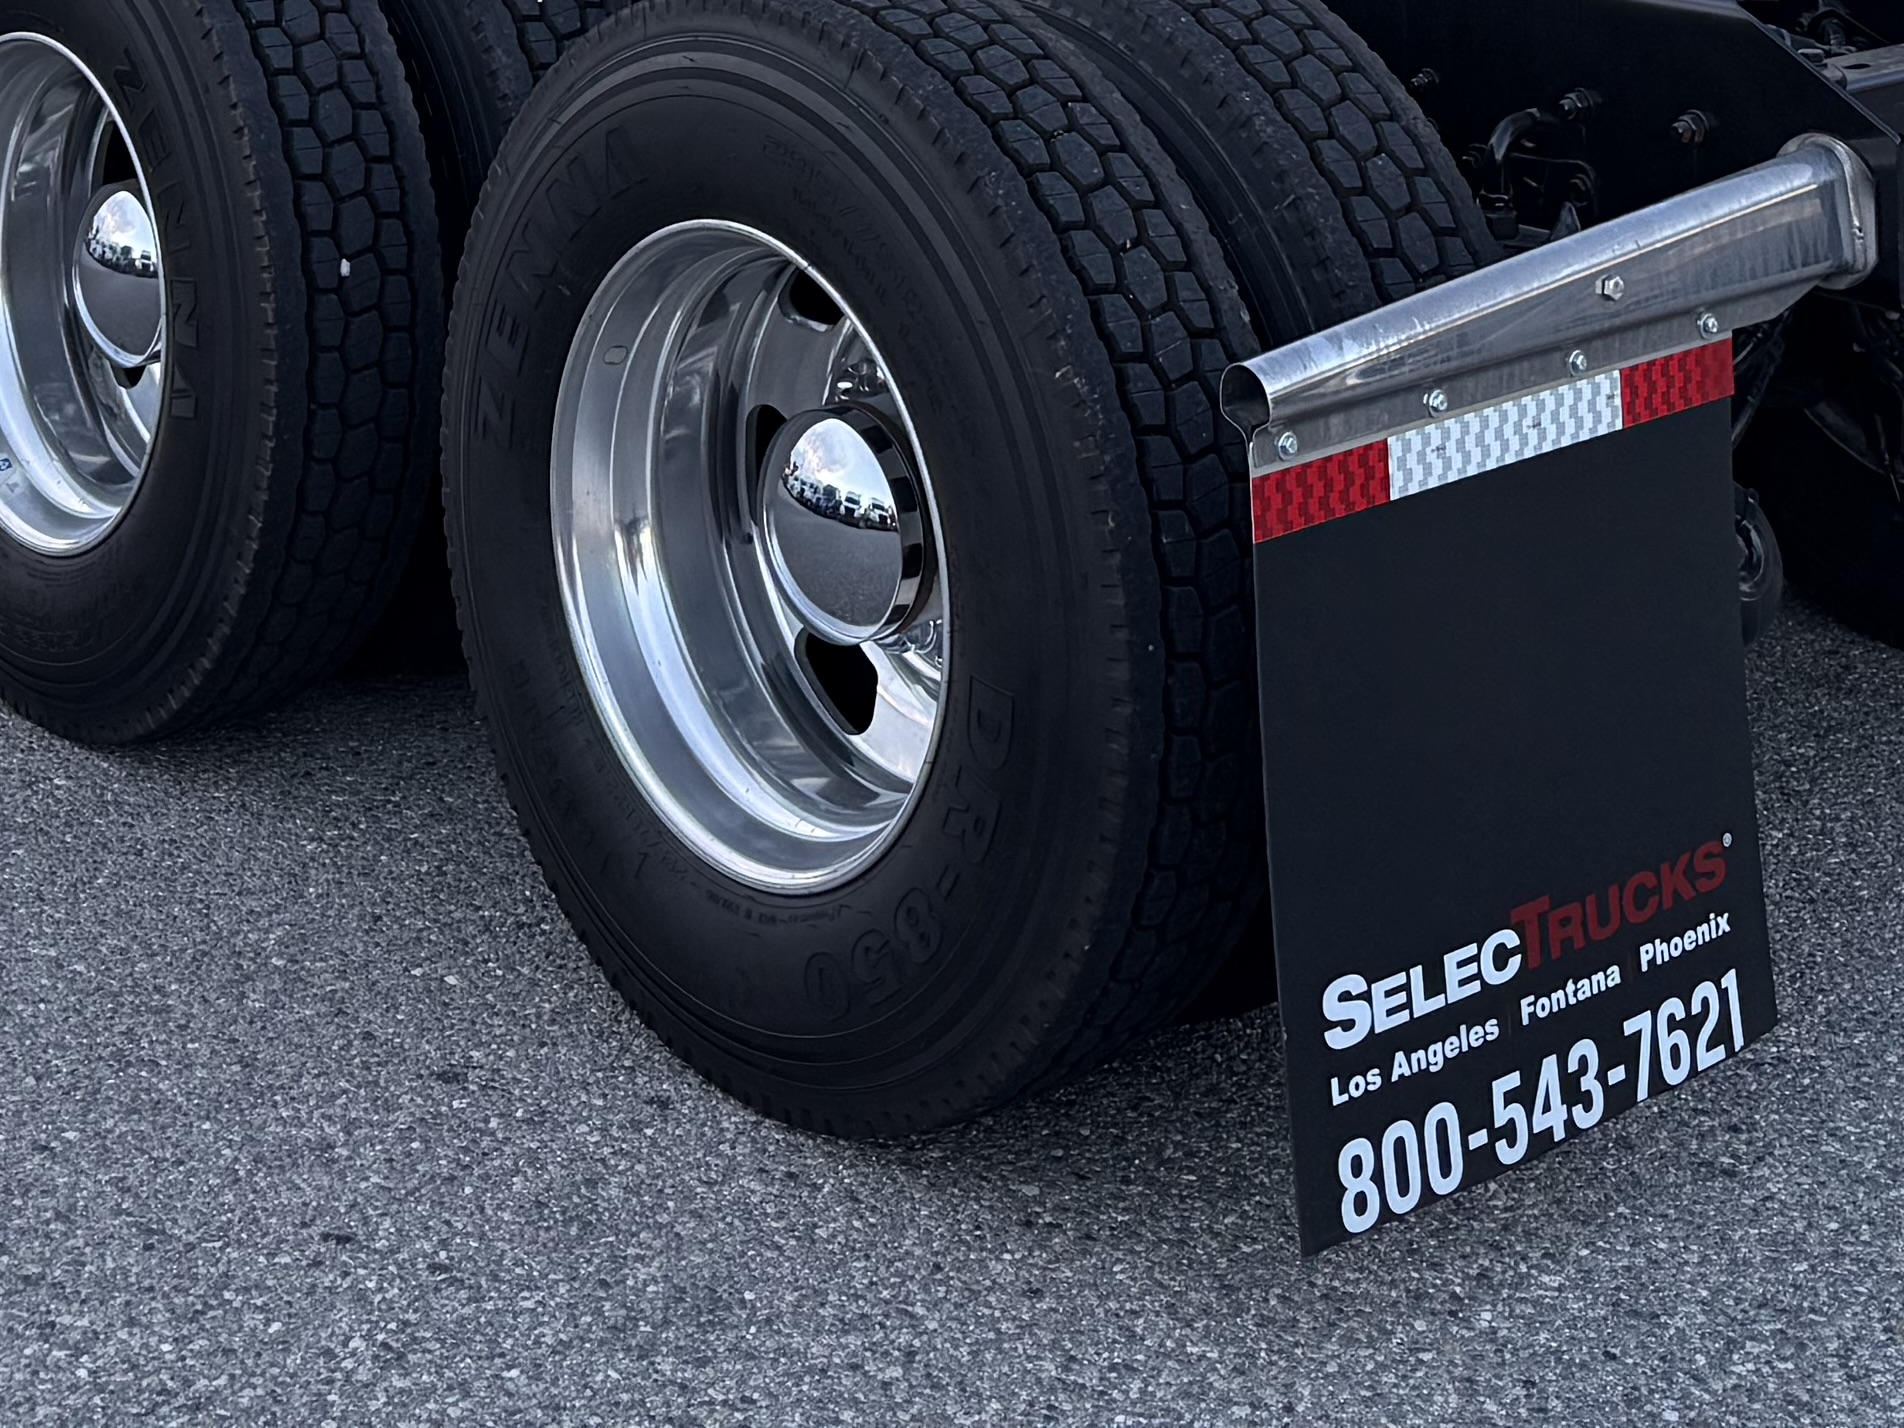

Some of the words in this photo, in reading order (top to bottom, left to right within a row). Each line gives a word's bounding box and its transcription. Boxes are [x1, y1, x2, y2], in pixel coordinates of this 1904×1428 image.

[112, 47, 199, 420] ZENNA
[475, 124, 648, 449] ZENNA
[803, 674, 1016, 1020] DR-850
[1330, 1066, 1382, 1106] Los
[1391, 1017, 1500, 1083] Angeles
[1520, 963, 1622, 1026] Fontana
[1639, 911, 1732, 972] Phoenix
[1338, 968, 1745, 1234] 800-543-7621
